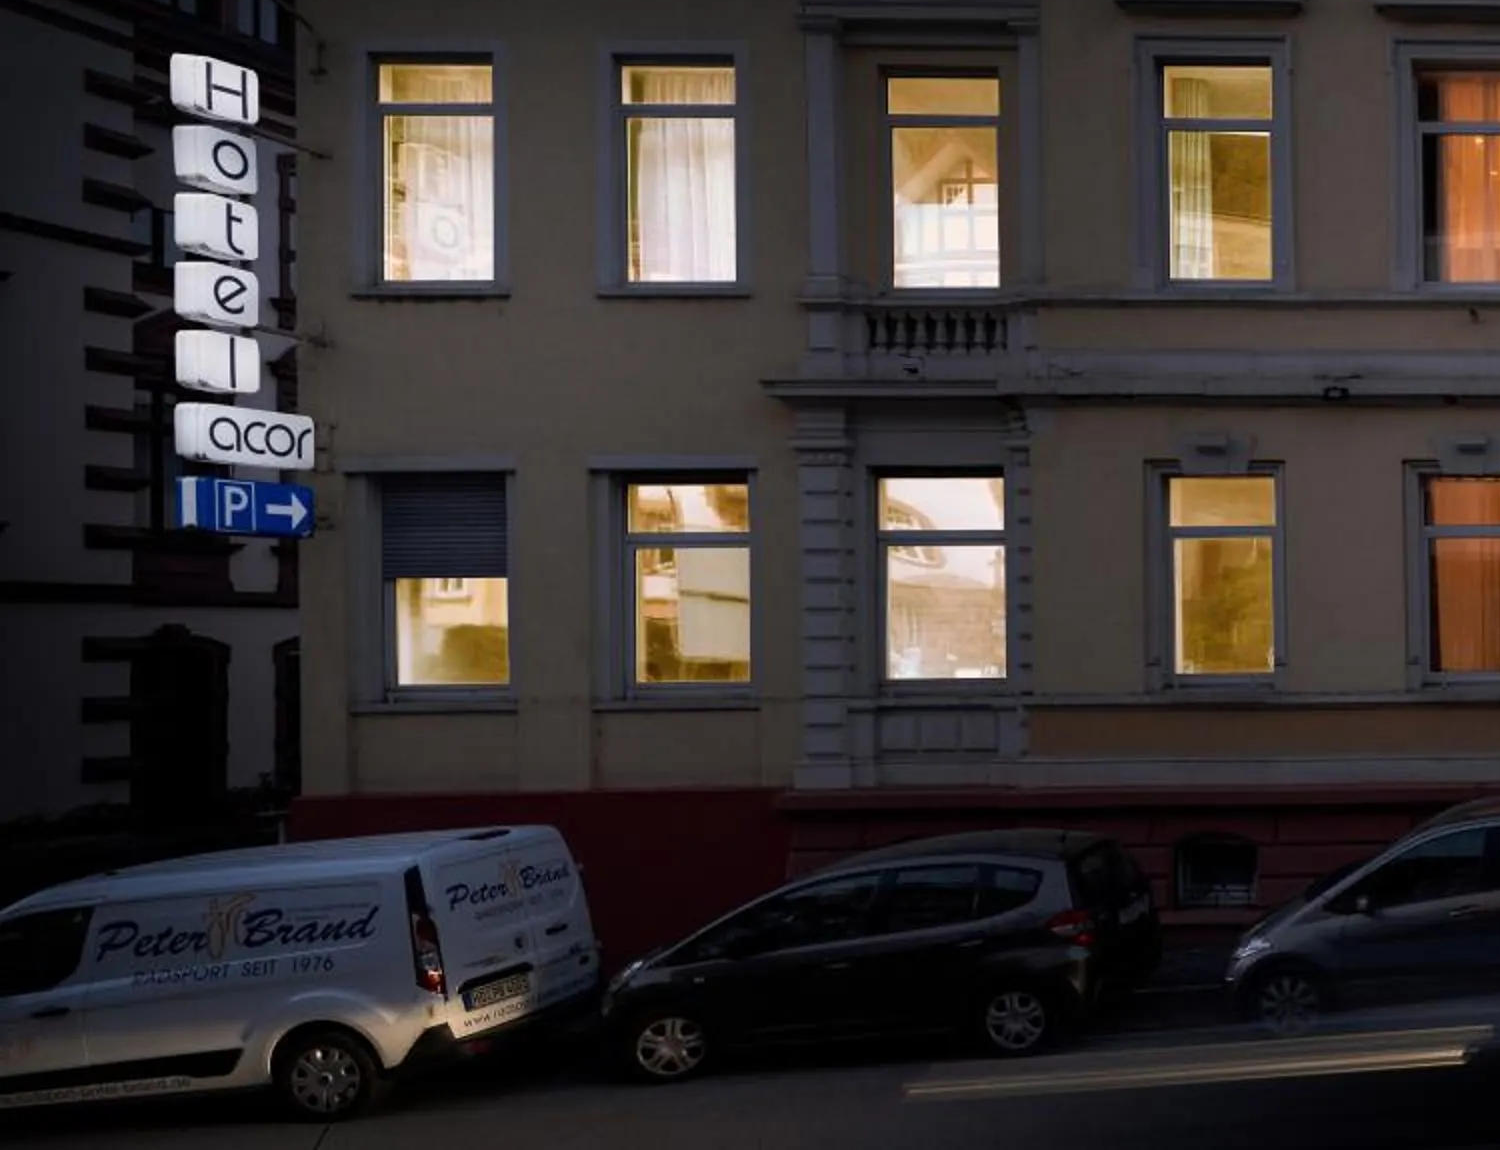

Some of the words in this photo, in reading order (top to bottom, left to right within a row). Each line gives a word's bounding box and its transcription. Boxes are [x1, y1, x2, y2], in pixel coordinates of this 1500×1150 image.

[205, 60, 249, 389] Hotel
[208, 416, 312, 460] acor
[223, 484, 250, 528] P
[446, 882, 508, 911] Peter
[96, 920, 208, 962] Peter
[243, 905, 380, 948] Brand
[240, 958, 278, 978] SEIT
[291, 955, 334, 974] 1976
